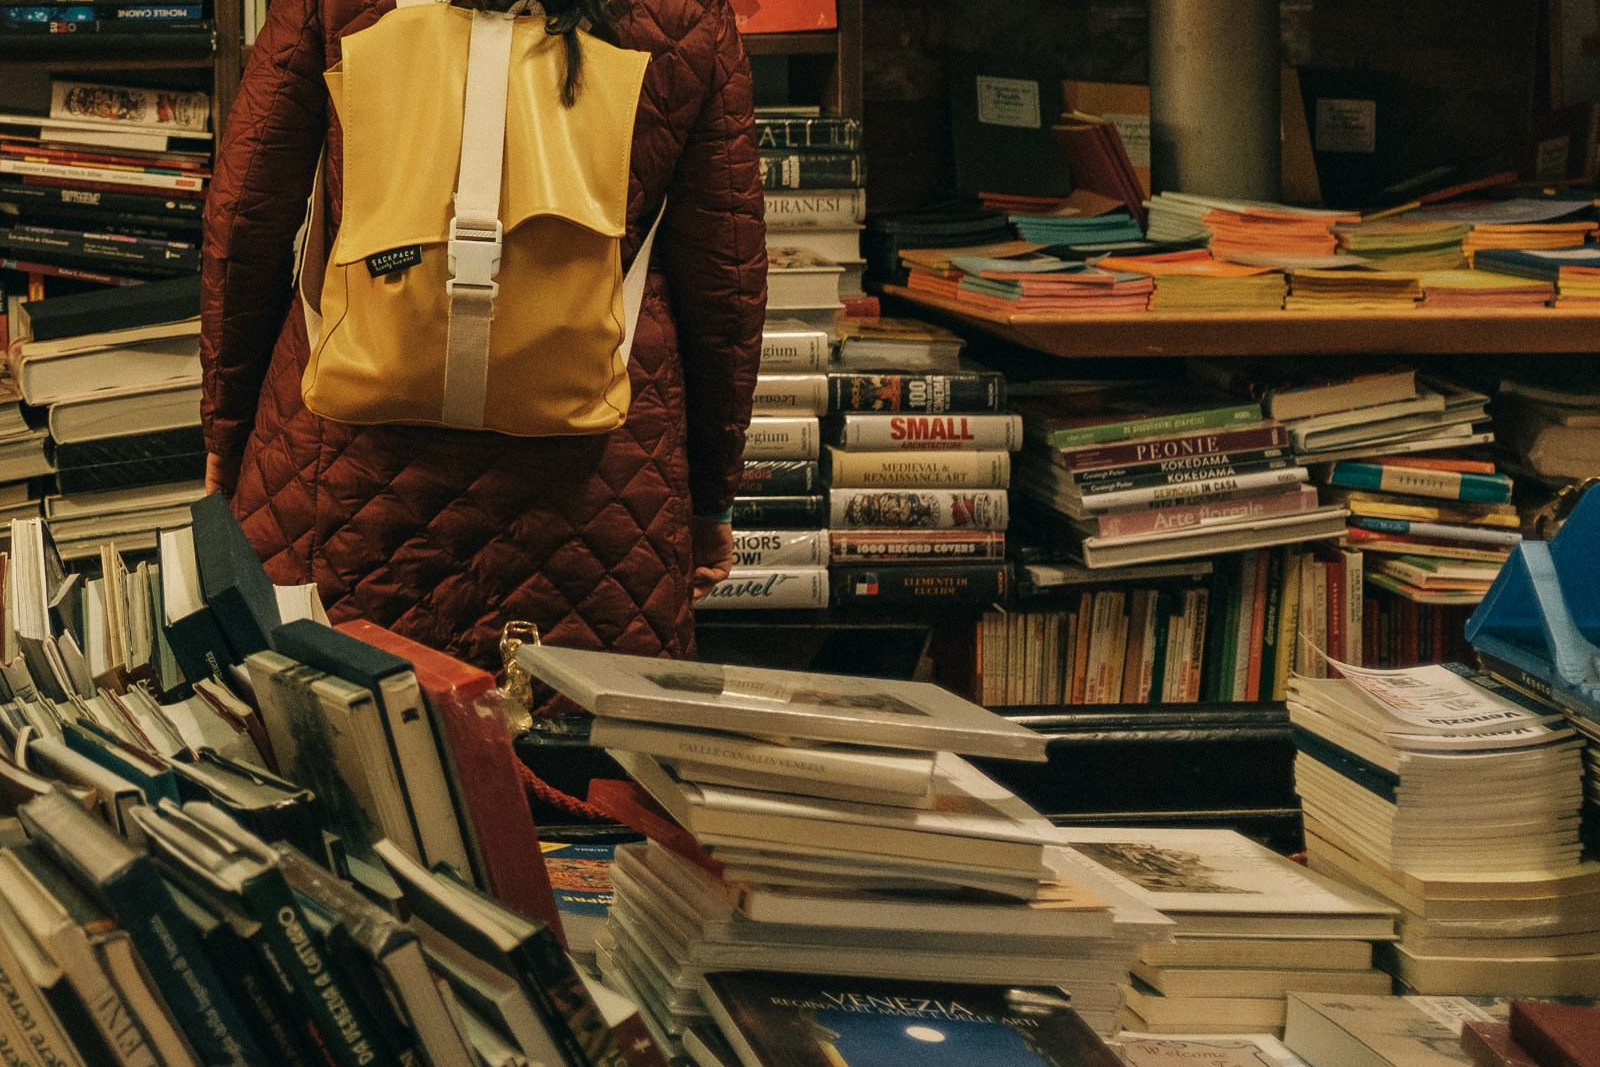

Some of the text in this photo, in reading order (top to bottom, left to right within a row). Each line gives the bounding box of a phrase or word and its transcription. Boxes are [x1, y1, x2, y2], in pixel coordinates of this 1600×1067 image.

[117, 9, 187, 18] MICHELE CARONE
[371, 250, 415, 267] SACKPACK
[890, 417, 975, 441] SMALL
[900, 441, 963, 450] ARCHITECTURE
[1136, 436, 1220, 461] PEONIE
[881, 463, 939, 474] MEDIEVAL
[863, 472, 968, 483] RENAISSANCE ART
[1214, 479, 1238, 492] CASA
[1153, 502, 1264, 530] Arte floreale
[856, 542, 976, 554] 1000 RECORD COVERS
[903, 576, 952, 586] ELEMENTI
[1426, 711, 1522, 726] Venezia
[820, 990, 974, 1016] VENEZIA
[769, 996, 839, 1010] REGINA
[841, 1003, 871, 1014] DEL
[878, 1007, 926, 1019] MARE
[946, 1012, 993, 1024] DELLE
[1001, 1016, 1040, 1028] ARTI
[1136, 1042, 1228, 1060] Welcome
